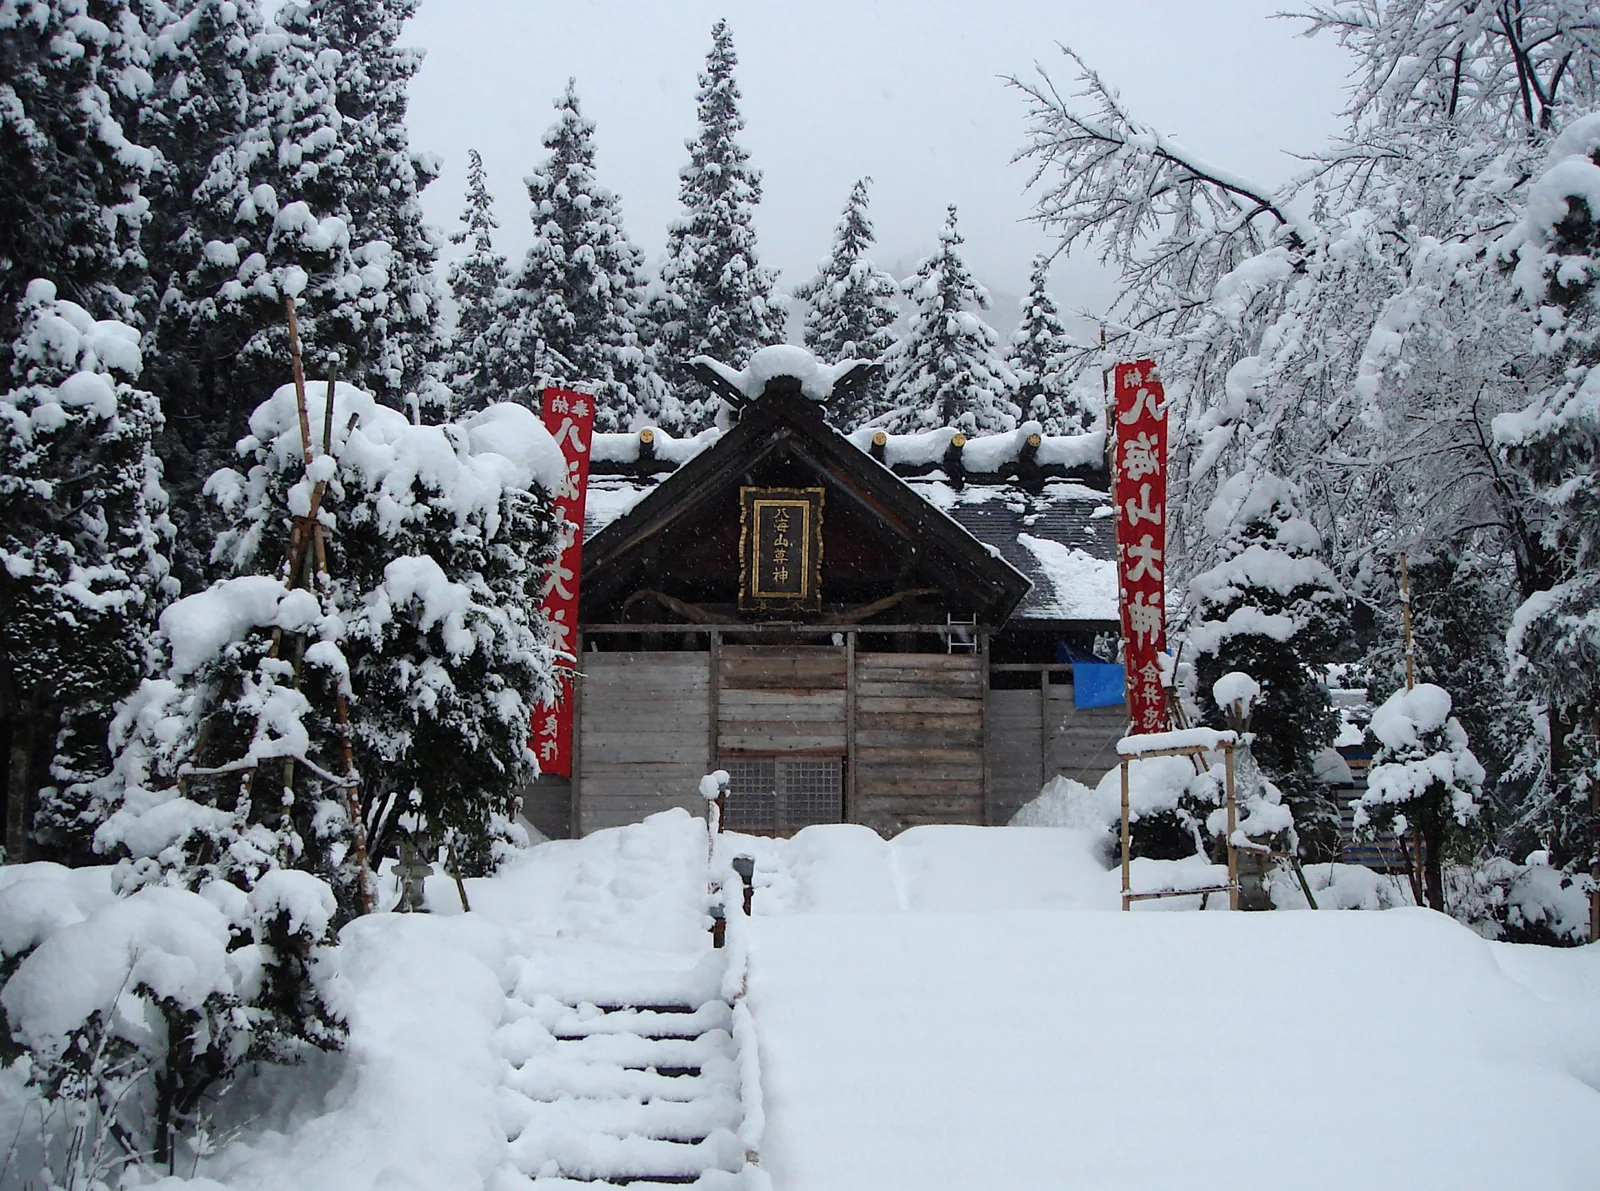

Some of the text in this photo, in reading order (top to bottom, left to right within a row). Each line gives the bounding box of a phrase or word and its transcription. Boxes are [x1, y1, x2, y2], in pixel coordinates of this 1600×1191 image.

[773, 507, 790, 586] 八海山尊神
